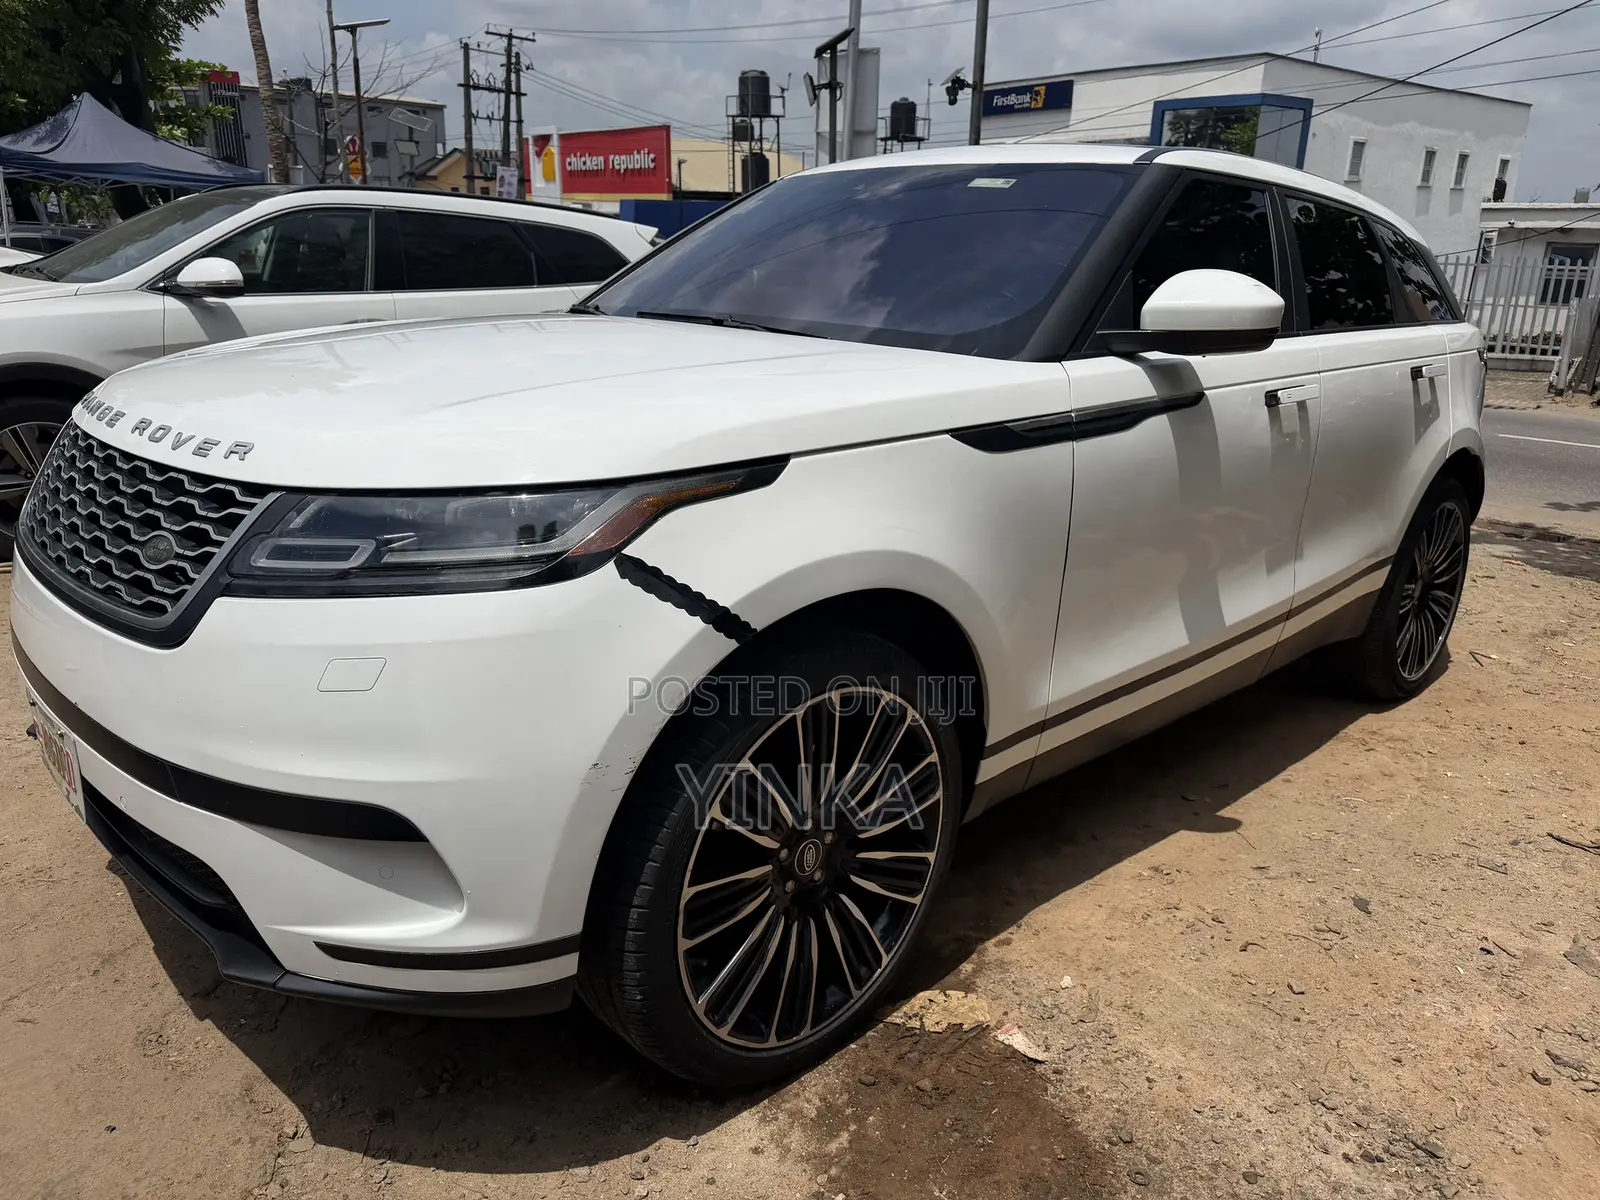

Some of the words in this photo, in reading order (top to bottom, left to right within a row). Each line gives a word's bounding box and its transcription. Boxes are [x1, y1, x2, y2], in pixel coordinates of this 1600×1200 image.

[992, 92, 1032, 107] FirstBank
[565, 152, 605, 171] chicken
[608, 148, 656, 174] republic
[80, 390, 126, 429] RANGE
[130, 417, 254, 461] ROVER
